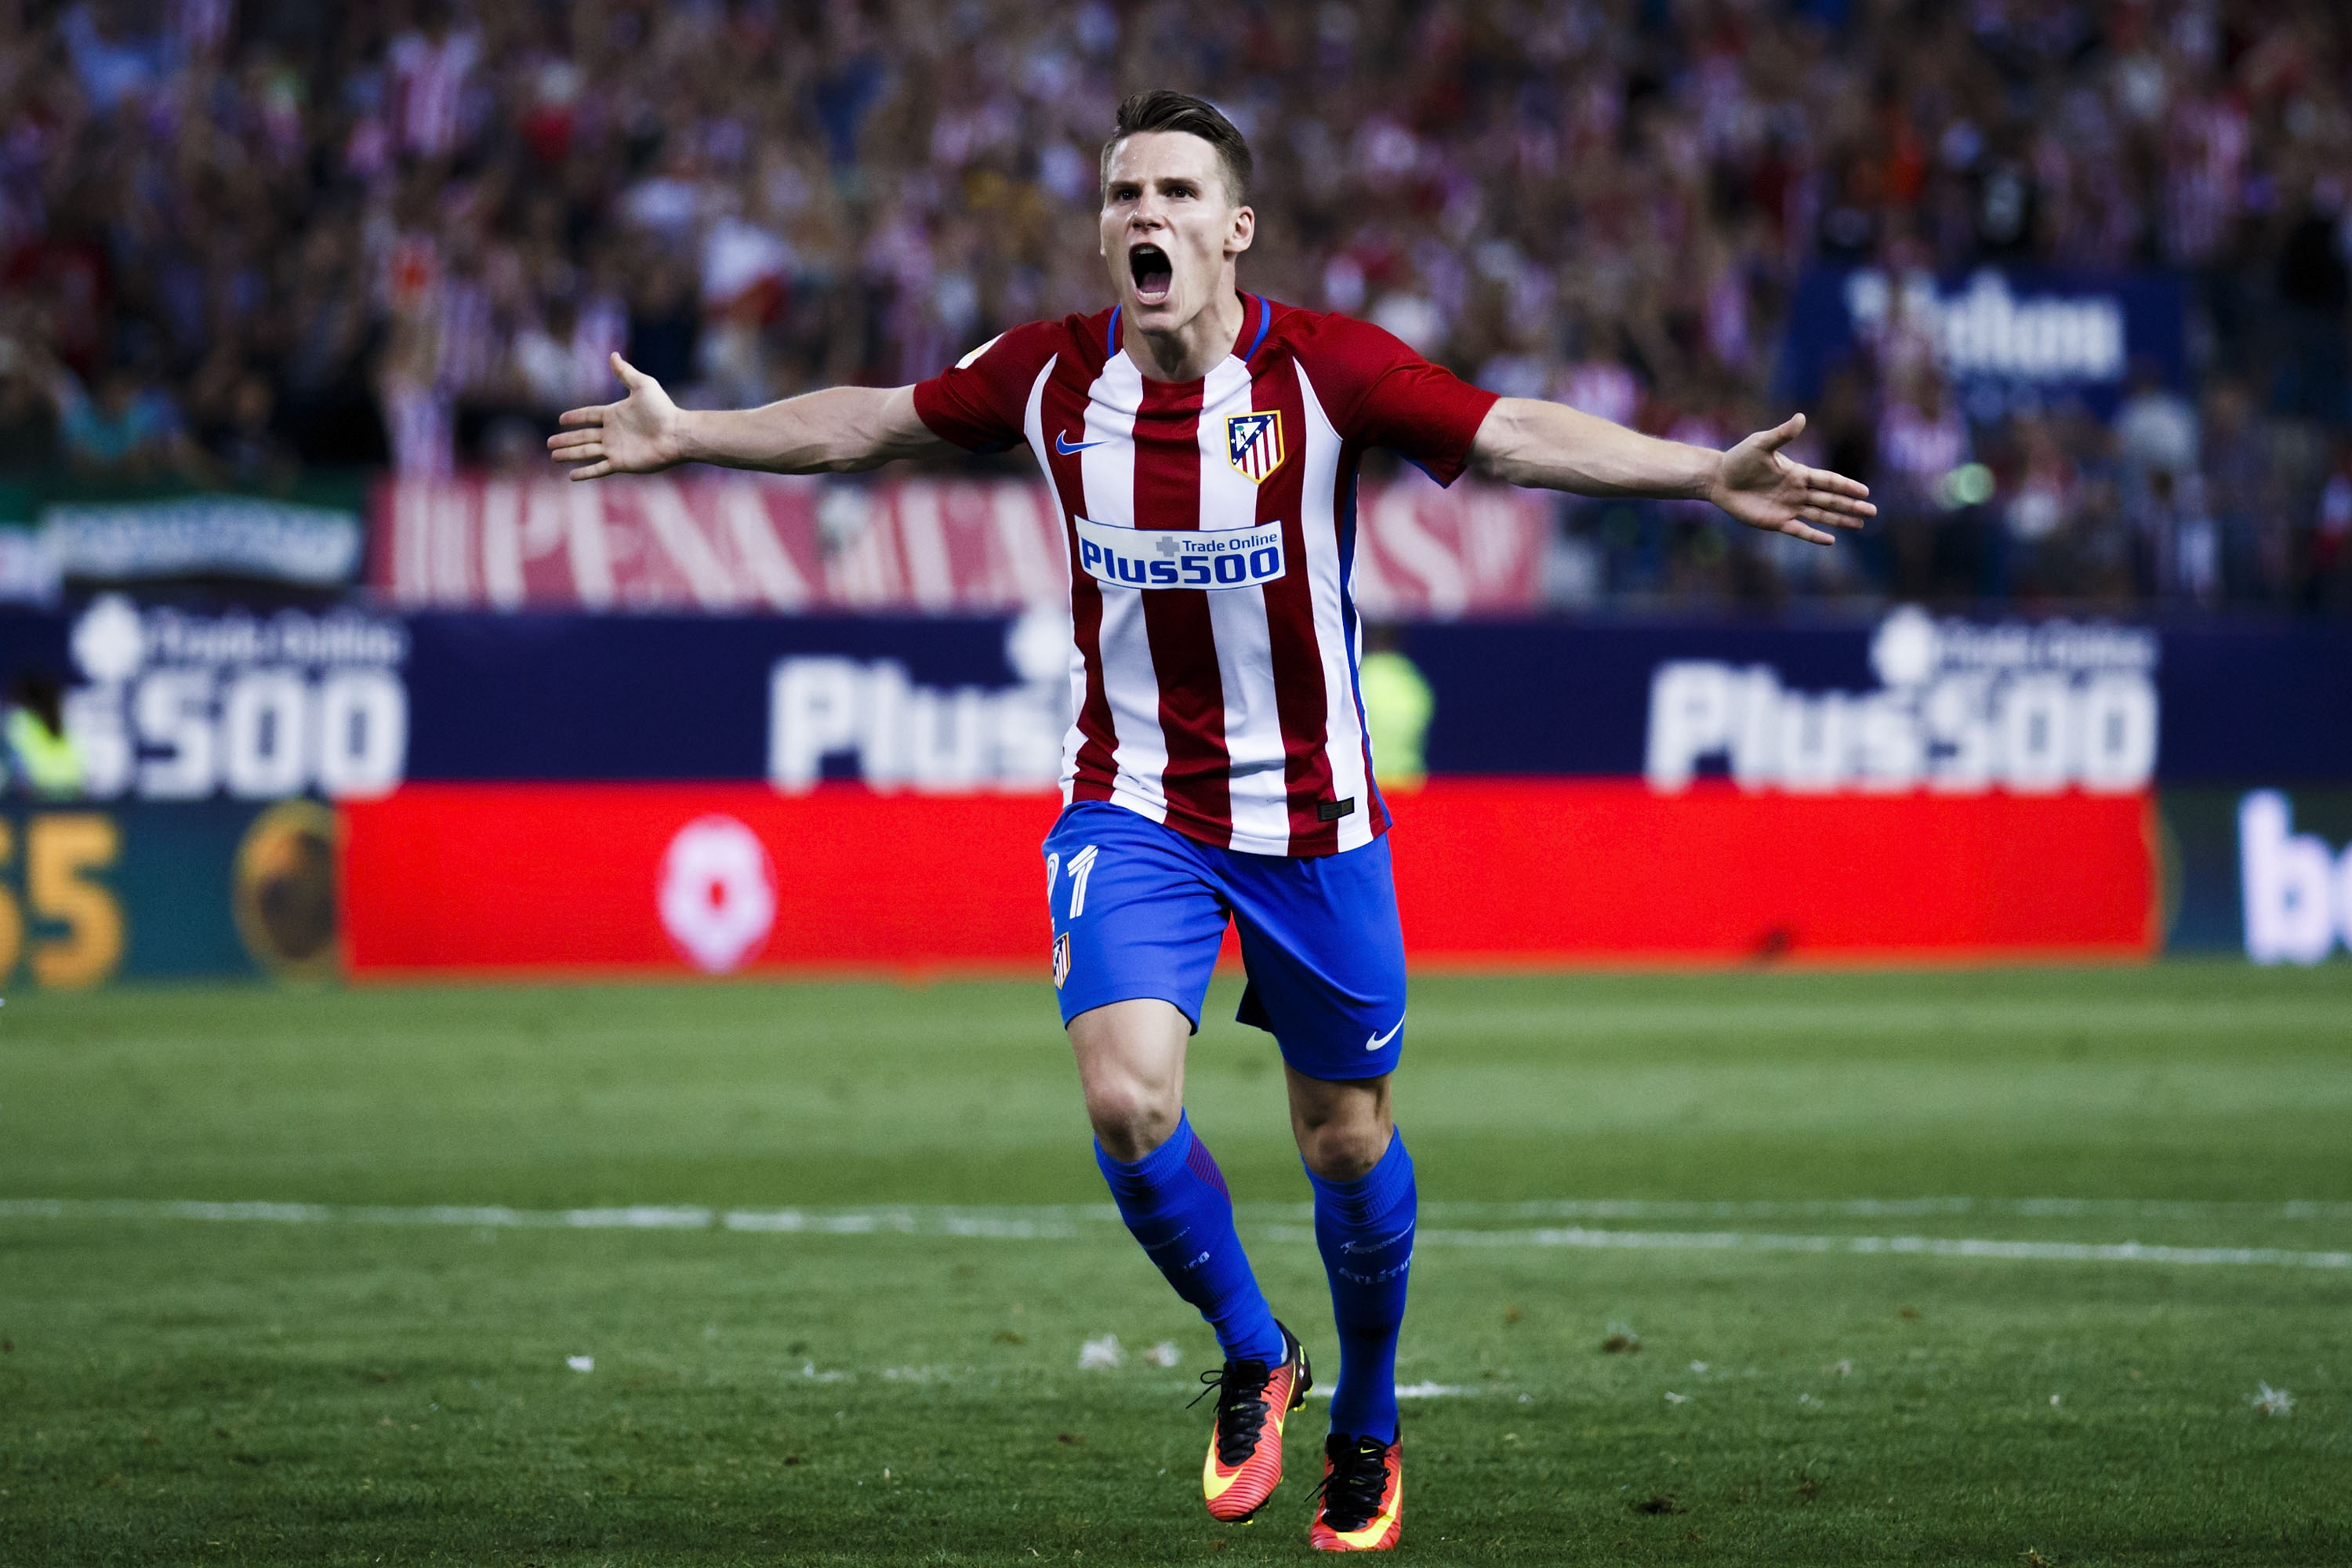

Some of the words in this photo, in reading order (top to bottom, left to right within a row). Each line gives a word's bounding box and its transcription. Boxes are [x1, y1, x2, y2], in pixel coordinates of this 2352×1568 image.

[1081, 537, 1279, 584] Plus500
[1182, 540, 1225, 552] Trade
[1229, 533, 1278, 549] Online
[1645, 660, 2158, 797] Plus500
[0, 811, 124, 989] 5
[2238, 788, 2352, 966] b
